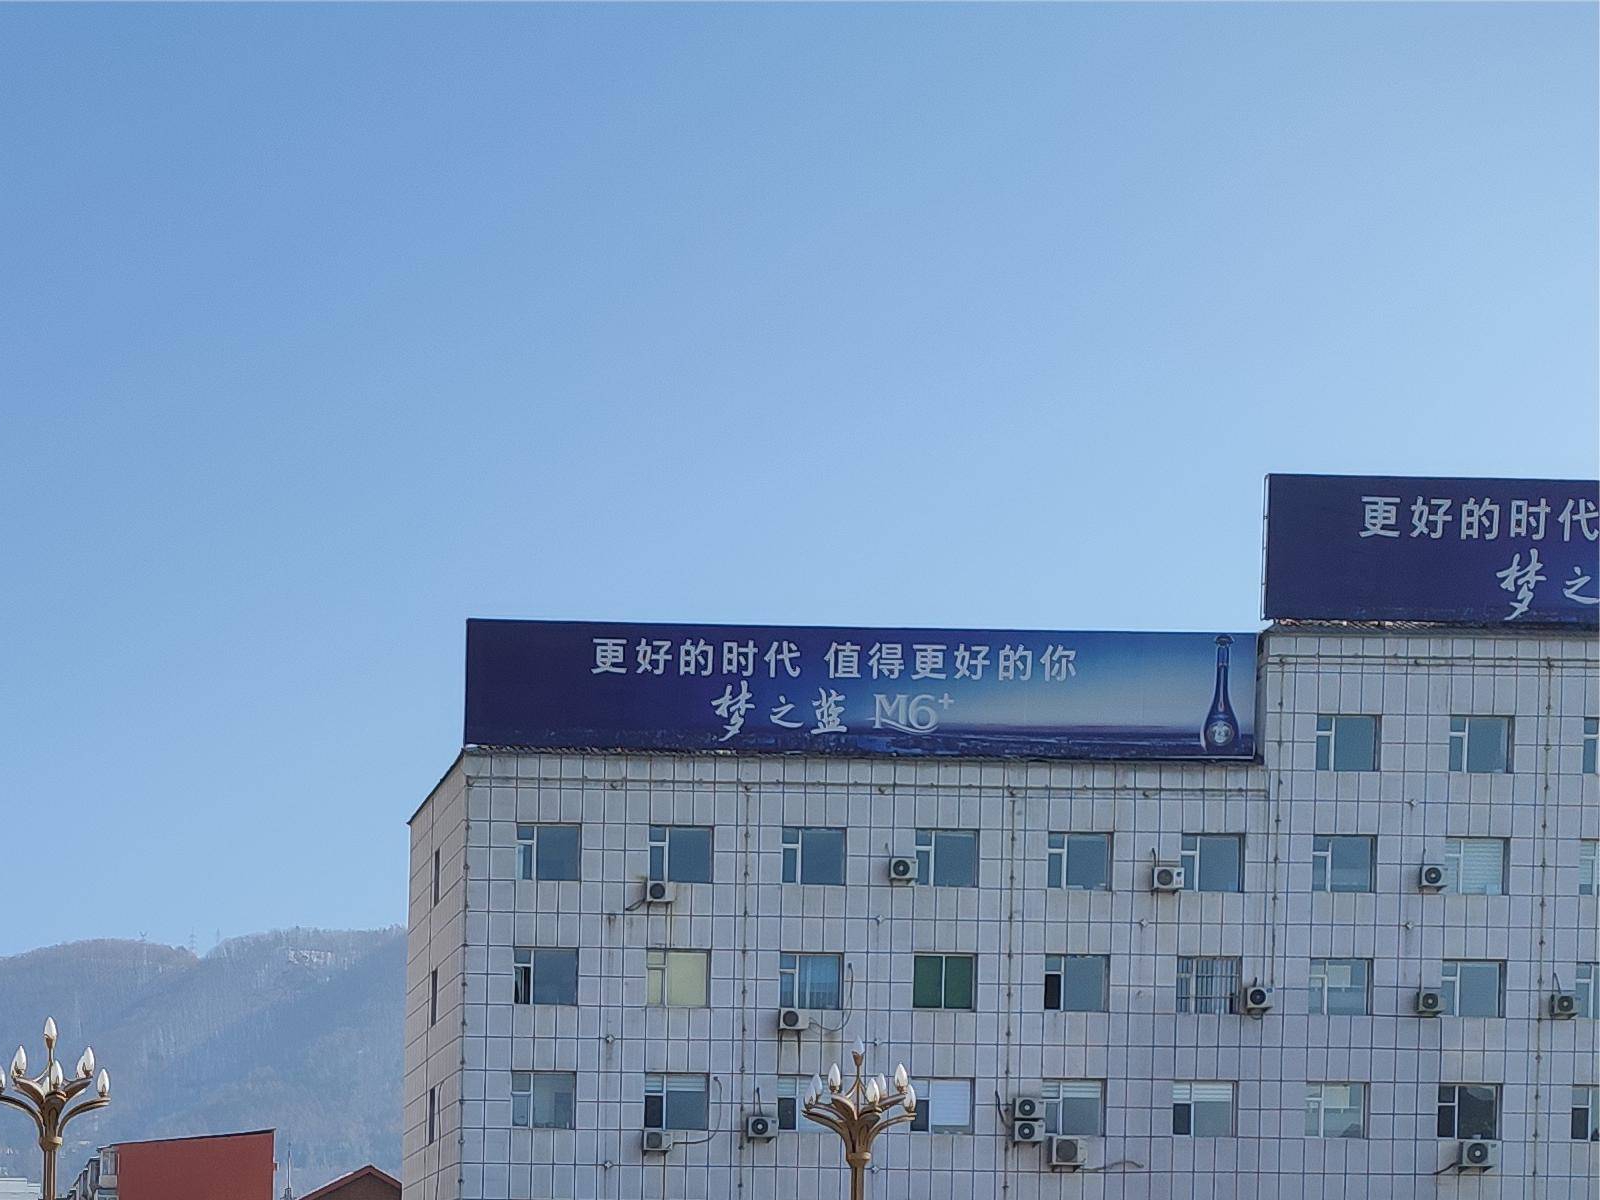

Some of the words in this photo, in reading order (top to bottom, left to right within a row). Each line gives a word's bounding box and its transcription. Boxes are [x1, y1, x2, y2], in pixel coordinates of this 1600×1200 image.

[1358, 495, 1600, 541] 更好的时代
[590, 637, 801, 679] 更好的时代
[823, 641, 1077, 682] 值得更好的你
[711, 680, 848, 742] 梦之蓝
